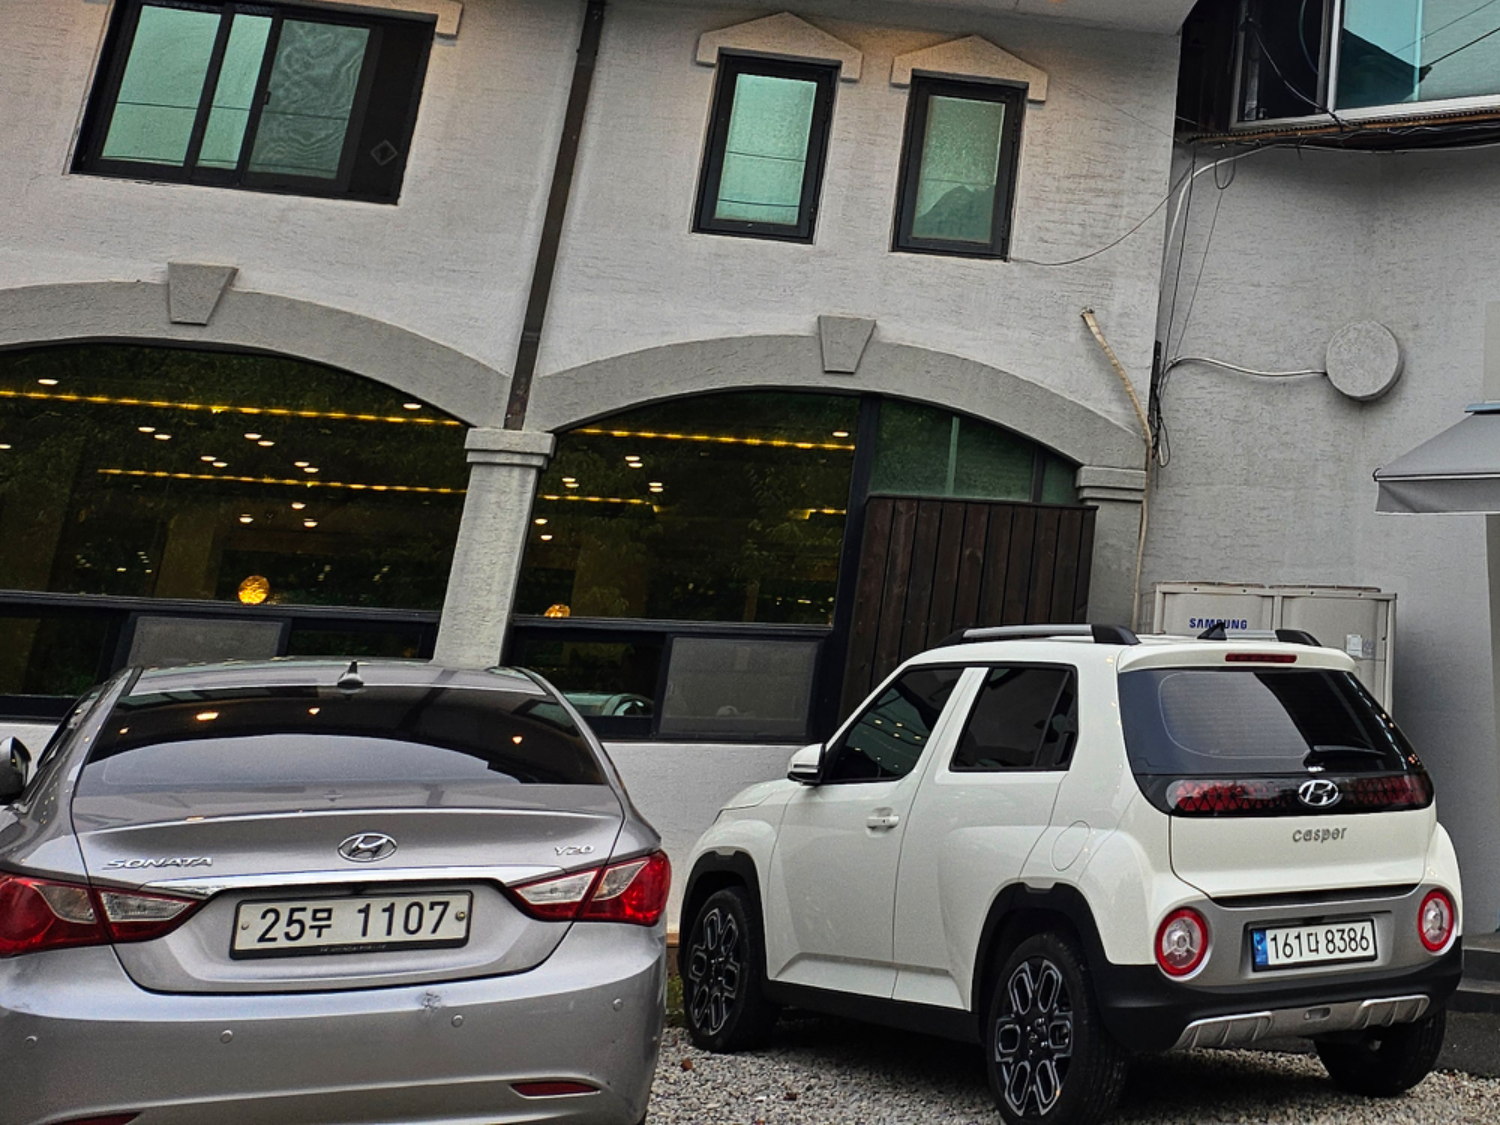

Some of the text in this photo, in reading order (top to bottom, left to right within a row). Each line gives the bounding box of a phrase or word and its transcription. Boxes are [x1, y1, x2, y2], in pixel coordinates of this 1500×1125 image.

[1293, 827, 1348, 844] casper
[102, 856, 214, 871] SONATA
[256, 900, 450, 943] 25무 1107
[1325, 926, 1370, 955] 8386
